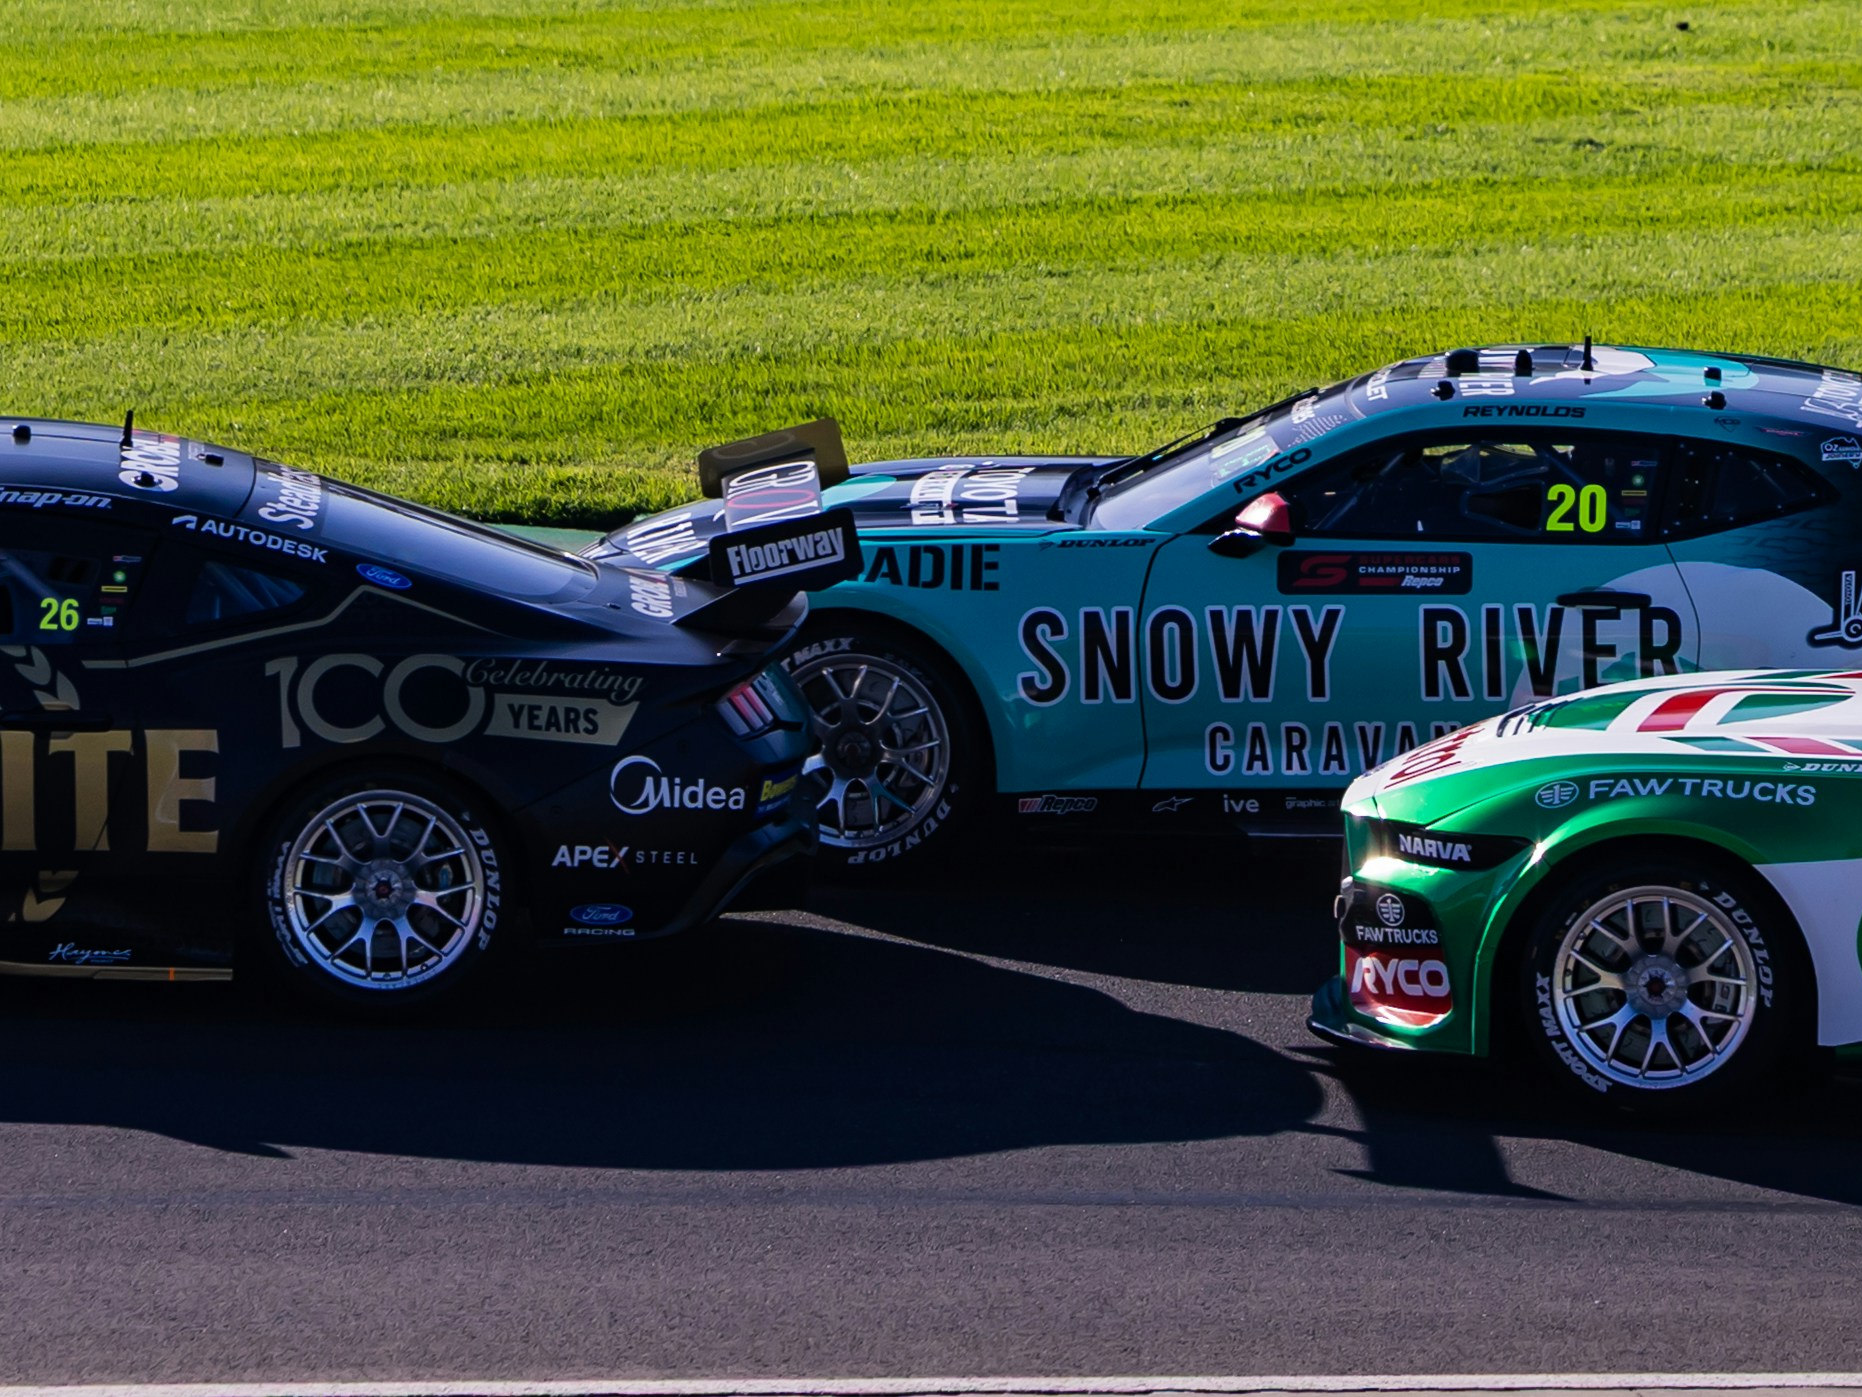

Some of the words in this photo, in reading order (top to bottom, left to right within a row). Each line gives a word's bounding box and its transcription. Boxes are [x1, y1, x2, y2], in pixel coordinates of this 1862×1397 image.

[1463, 404, 1587, 418] REYNOLDS
[1233, 447, 1312, 495] RYCO
[0, 487, 112, 508] nap-on
[728, 460, 820, 527] GROV
[1545, 483, 1608, 533] 20
[201, 518, 328, 564] AUTODESK
[727, 527, 843, 578] Floorway
[1060, 538, 1155, 548] DUNLOP
[361, 565, 407, 587] Ford
[856, 543, 1000, 591] ADIE
[1358, 565, 1461, 574] CHAMPIONSHIP
[1401, 574, 1444, 588] Repco
[39, 596, 79, 632] 26
[1017, 604, 1346, 707] SNOWY
[1418, 603, 1683, 702] RIVER
[464, 658, 644, 701] Celebrating
[507, 703, 600, 736] YEARS
[1204, 721, 1461, 776] CARAVA
[611, 757, 745, 814] Midea
[1039, 794, 1099, 813] Repco
[1223, 793, 1260, 813] ive
[1679, 778, 1817, 806] TRUCKS
[847, 797, 952, 865] DUNLOP
[1400, 833, 1471, 862] NARVA
[551, 844, 629, 871] APEX
[636, 851, 698, 865] STEEL
[469, 827, 501, 952] DUNLOP
[564, 928, 635, 936] RACING
[575, 904, 628, 924] Ford
[1713, 890, 1774, 1009] DUNLOP
[1351, 956, 1450, 998] RYCO
[1536, 971, 1559, 1038] MAXX
[1551, 1039, 1614, 1094] SPORT
